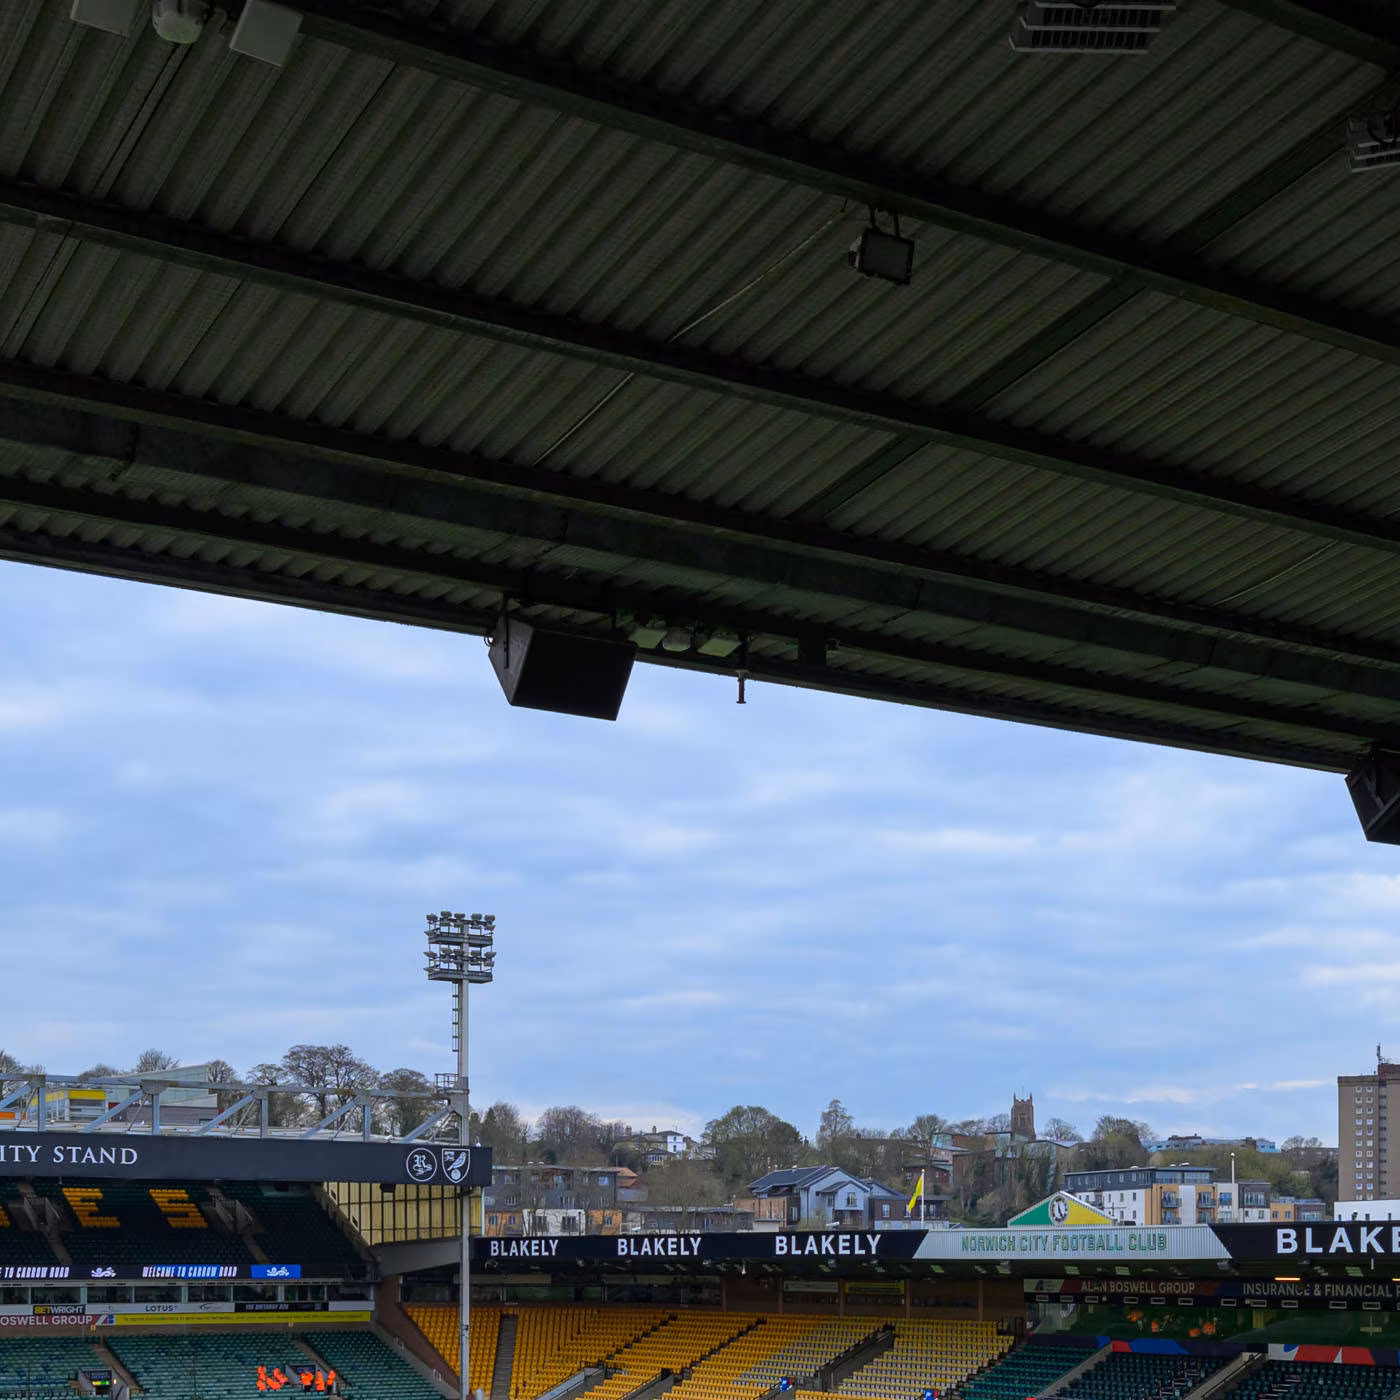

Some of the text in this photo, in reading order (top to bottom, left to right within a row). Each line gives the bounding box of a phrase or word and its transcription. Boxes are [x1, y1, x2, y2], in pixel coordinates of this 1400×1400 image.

[53, 1145, 138, 1165] STAND
[490, 1240, 559, 1257] BLAKELY
[617, 1237, 702, 1256] BLAKELY
[775, 1233, 881, 1256] BLAKELY
[961, 1233, 1167, 1251] NORWICH CITY FOOTBALL CLUB
[4, 1267, 14, 1278] TO
[16, 1267, 47, 1278] CARROW
[50, 1267, 69, 1278] ROAD
[142, 1266, 237, 1278] WELCOME TO CARROW ROAD
[1080, 1281, 1195, 1294] ALAN BOSWELL GROUP
[1243, 1283, 1311, 1297] INSURANCE
[1324, 1284, 1393, 1297] FINANCIAL
[34, 1305, 85, 1315] BETWRIGHT
[52, 1315, 93, 1325] GROUP
